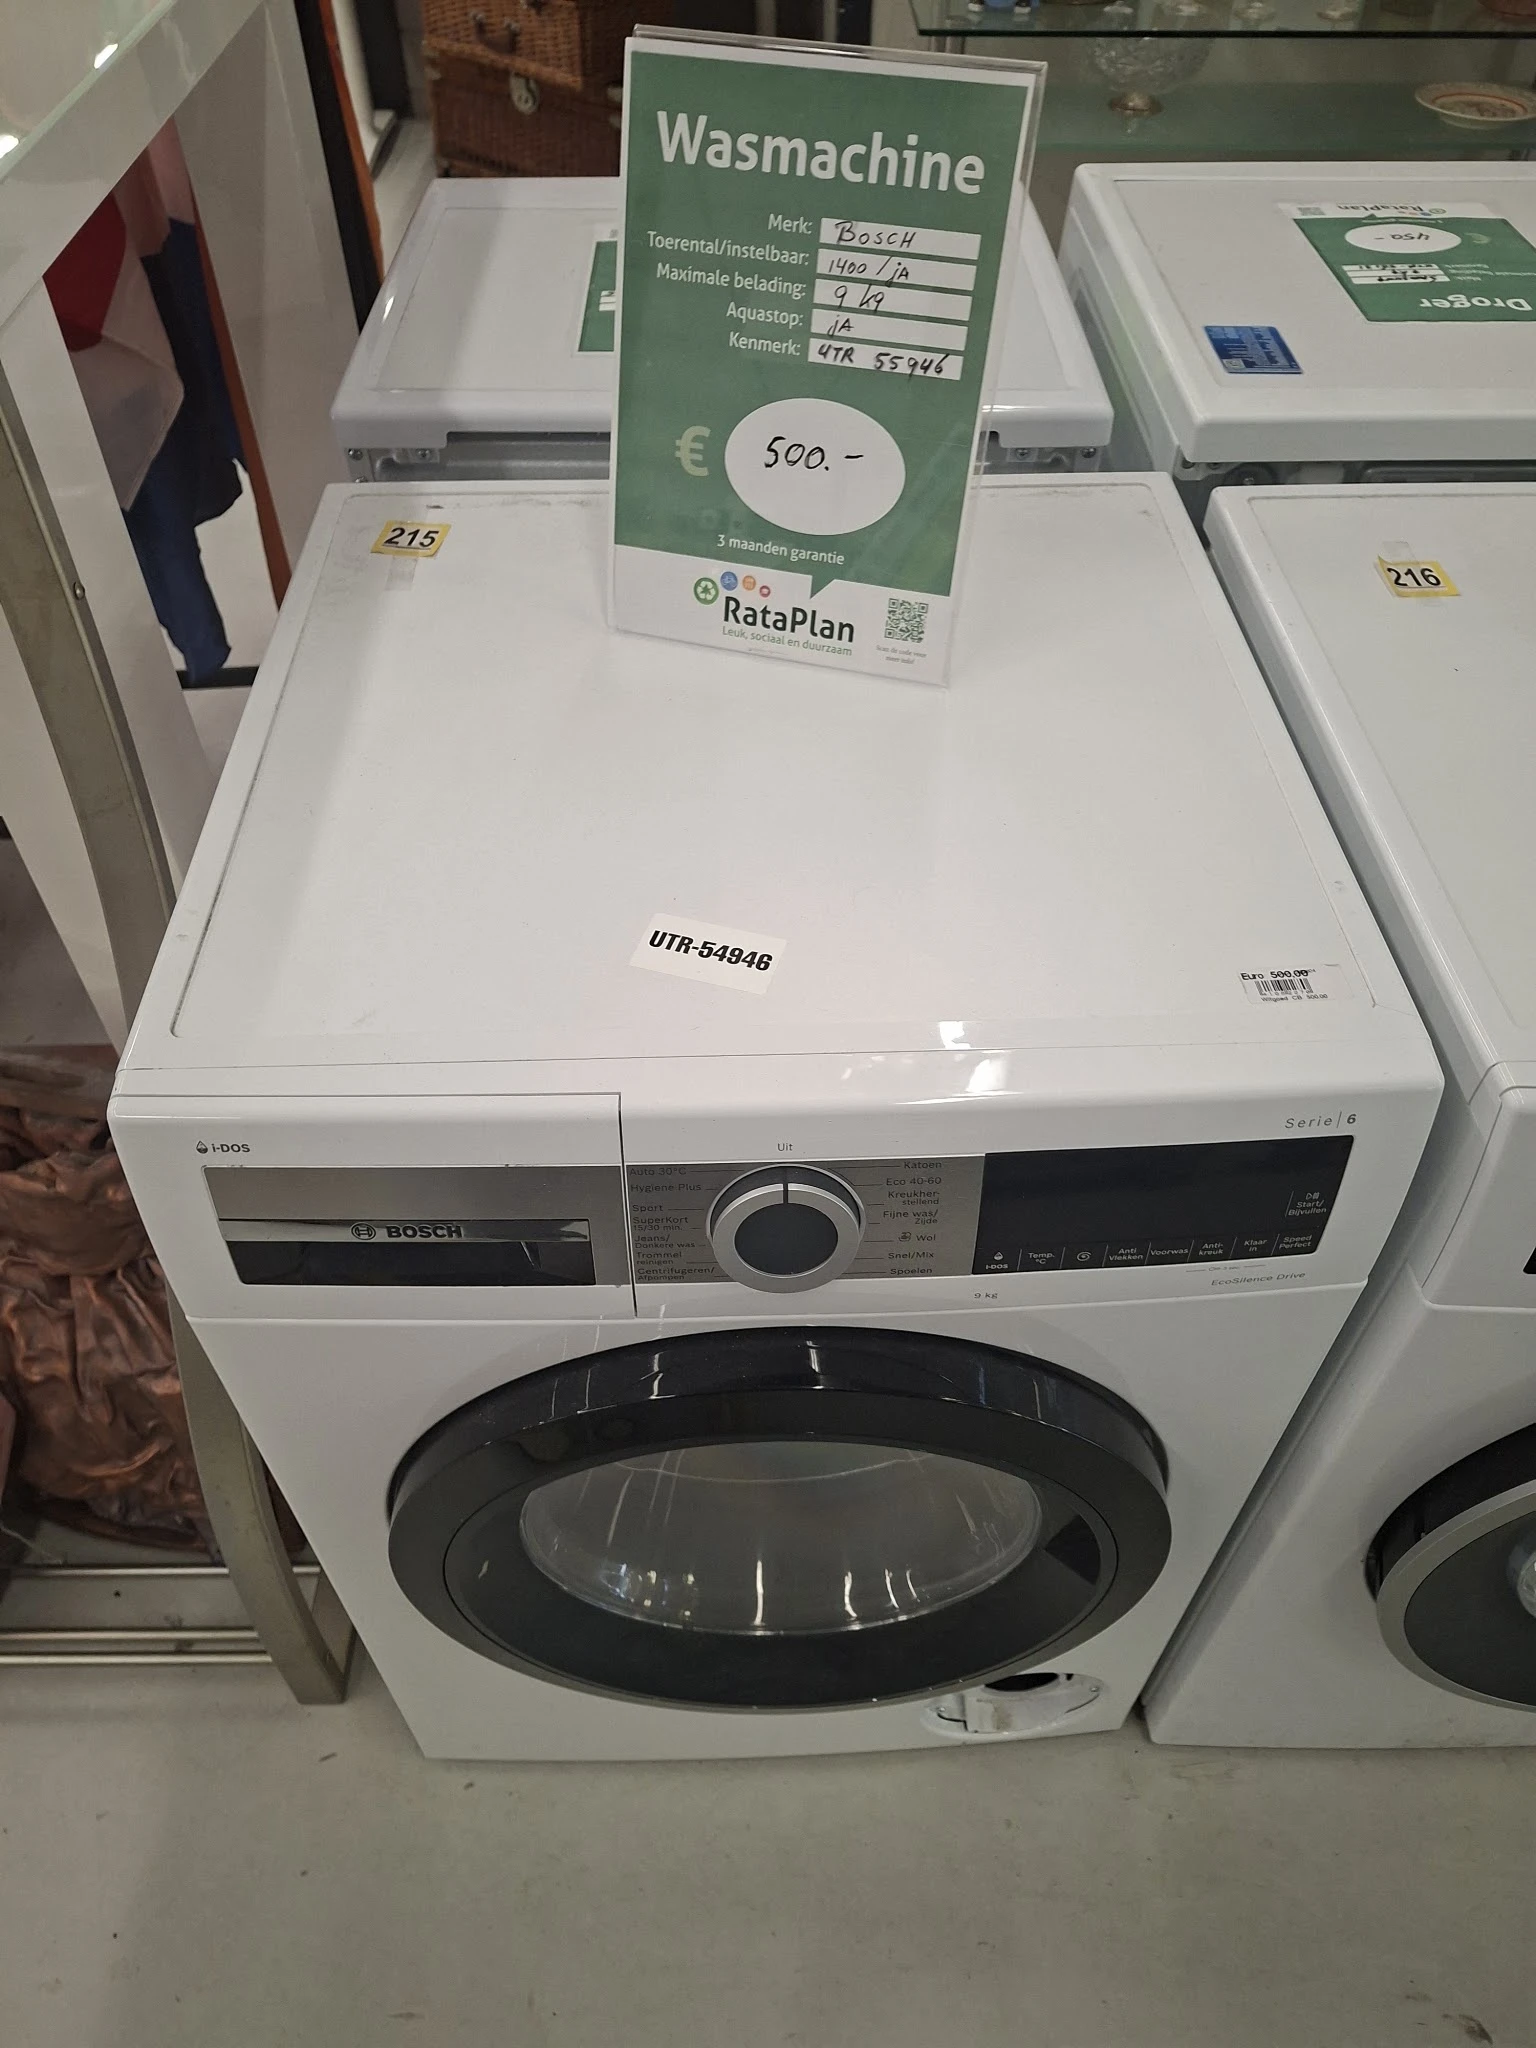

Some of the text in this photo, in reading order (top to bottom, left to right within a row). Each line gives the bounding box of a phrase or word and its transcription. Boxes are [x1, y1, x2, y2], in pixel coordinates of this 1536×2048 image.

[657, 110, 985, 194] Wasmachine
[767, 213, 916, 249] Merk: BOSCH
[647, 231, 809, 265] Toerental/instelbaar:
[828, 258, 868, 274] 1400
[656, 262, 730, 287] Maximale
[734, 272, 806, 300] belading:
[834, 285, 847, 308] 9
[1419, 294, 1533, 311] Droger
[726, 302, 803, 329] Aquastop:
[729, 331, 801, 356] Kenmerk:
[874, 353, 950, 379] 55946
[675, 425, 711, 477] €
[383, 527, 440, 548] 215
[717, 535, 845, 565] 3 maanden garantie
[1386, 567, 1441, 587] 216
[724, 595, 855, 643] RataPlan
[722, 626, 853, 656] Leuk, sociaal en duurzaam
[649, 930, 773, 971] UTR-54946
[1240, 972, 1265, 981] Euro
[1270, 969, 1309, 979] 500.00
[211, 1143, 251, 1153] i-DOS
[777, 1142, 794, 1152] Uit
[903, 1161, 942, 1169] Katoen
[629, 1167, 687, 1176] Auto 30°C
[886, 1177, 942, 1186] Eco 40-60
[630, 1183, 702, 1194] Hygiene Plus
[888, 1190, 941, 1199] Kreukher-
[632, 1204, 664, 1213] Sport
[1296, 1199, 1325, 1209] Start/
[883, 1209, 939, 1219] Fijne was/
[1288, 1207, 1327, 1217] Bijvullen
[633, 1216, 689, 1225] SuperKort
[385, 1224, 463, 1239] BOSCH
[634, 1234, 671, 1242] Jeans/
[916, 1234, 937, 1242] Wol
[1244, 1238, 1267, 1247] Klaar
[1283, 1234, 1313, 1243] Speed
[1202, 1242, 1224, 1250] Anti-
[1279, 1241, 1312, 1250] Perfect
[637, 1251, 682, 1259] Trommel
[888, 1252, 935, 1260] Snel/Mix
[1028, 1252, 1056, 1260] Temp.
[1118, 1247, 1137, 1255] Anti
[1150, 1247, 1189, 1256] Voorwas
[1199, 1248, 1224, 1256] kreuk
[1108, 1254, 1144, 1262] Vlekken
[637, 1266, 715, 1276] Centrifugeren/
[890, 1268, 933, 1276] Spoelen
[1211, 1272, 1306, 1286] EcoSilence Drive
[985, 1292, 998, 1300] kg
